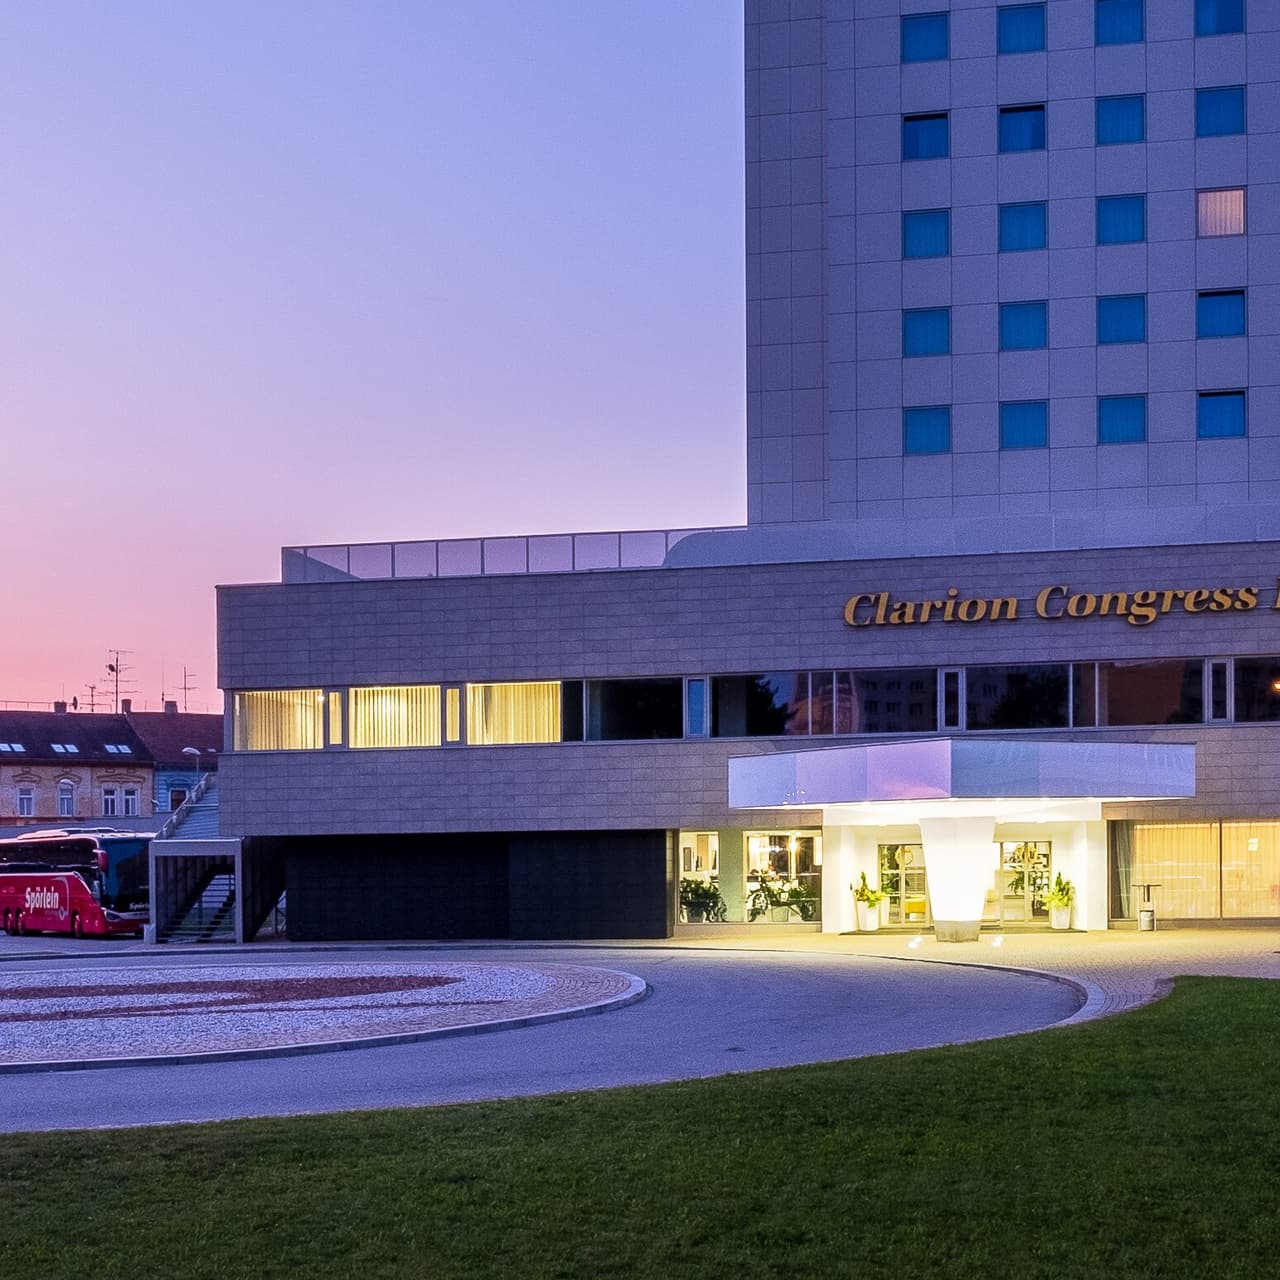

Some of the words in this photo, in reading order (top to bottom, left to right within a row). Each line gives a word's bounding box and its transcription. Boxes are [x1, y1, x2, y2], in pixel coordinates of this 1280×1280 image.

[844, 587, 1018, 626] Clarion
[1035, 581, 1260, 625] Congress
[25, 886, 59, 914] Spörlein
